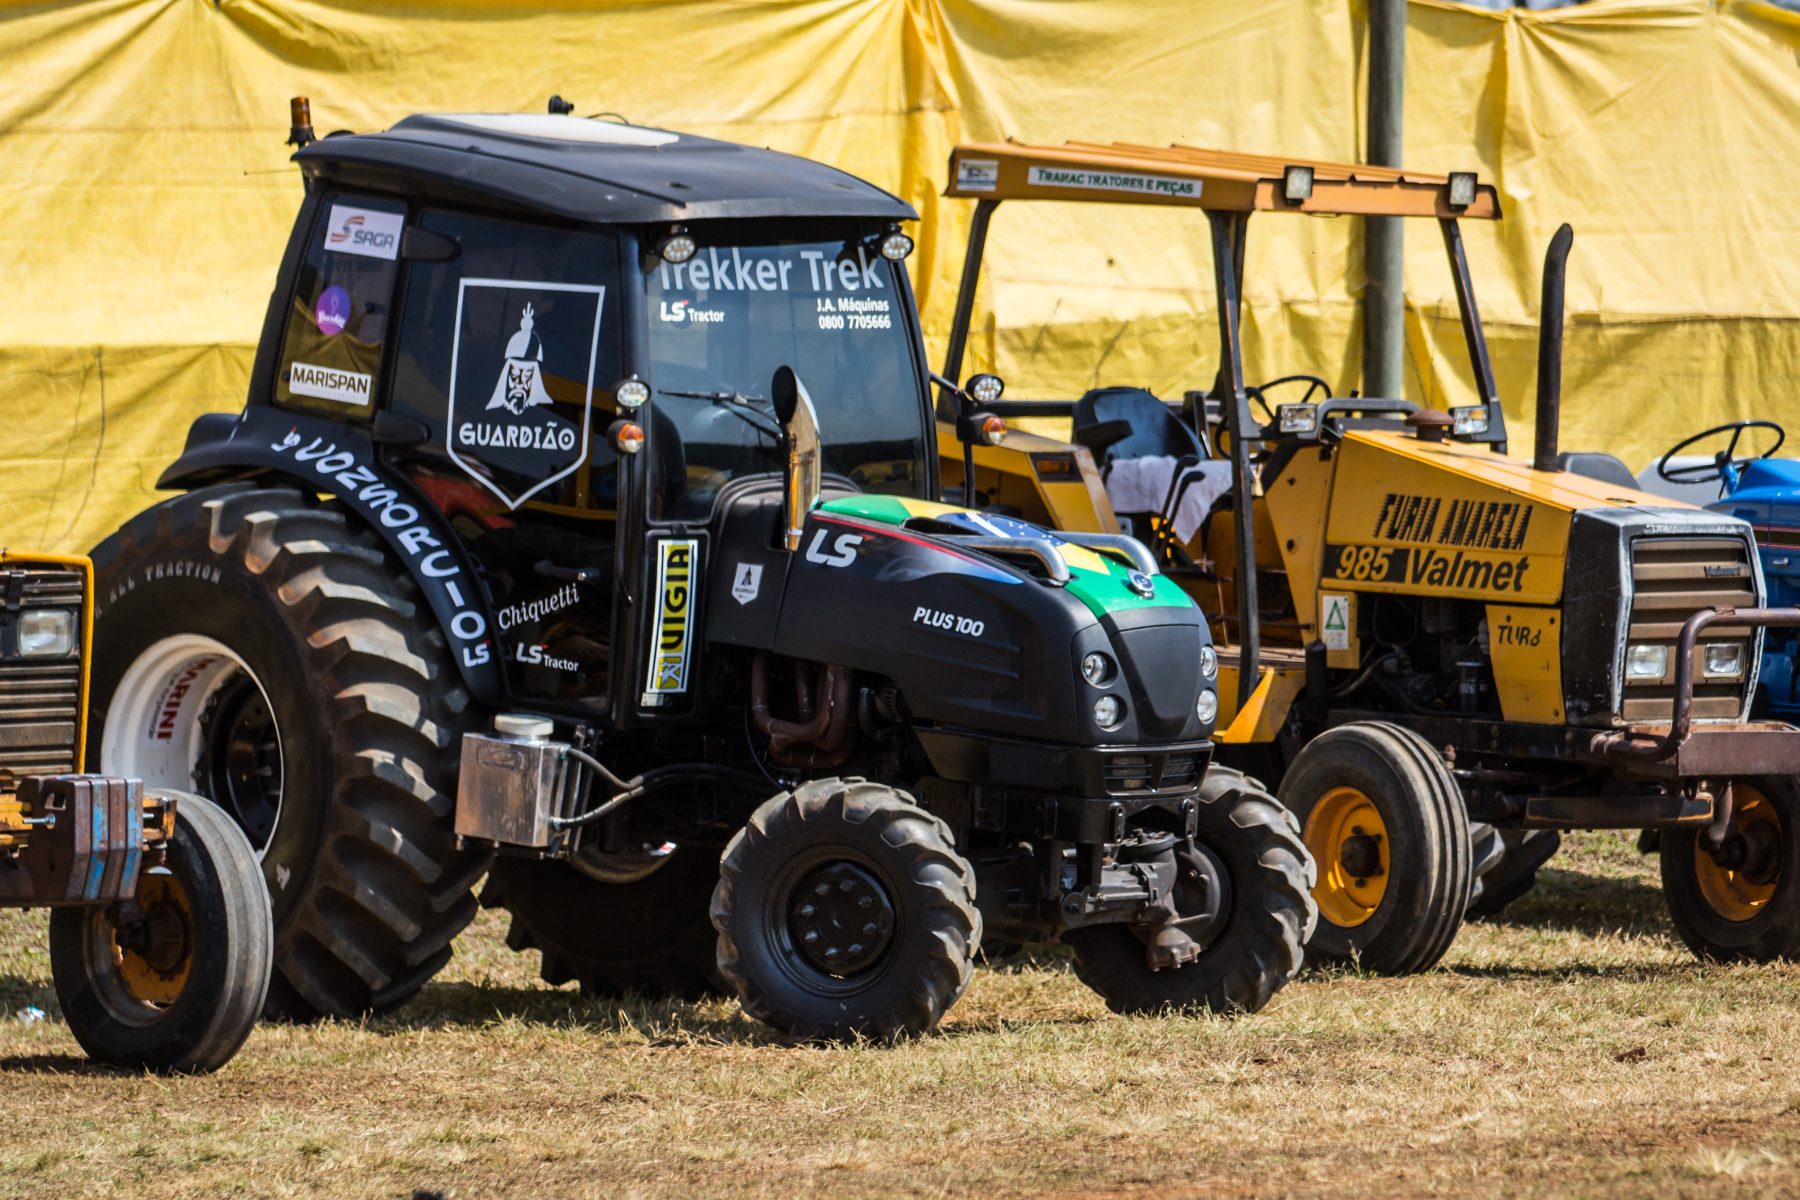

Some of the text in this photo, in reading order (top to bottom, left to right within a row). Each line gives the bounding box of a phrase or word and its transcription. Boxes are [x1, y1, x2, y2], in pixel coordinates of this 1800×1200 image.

[1036, 169, 1194, 196] TRAMAC TRATORES E PEÇAS
[352, 230, 395, 250] SAGA
[800, 246, 885, 292] Trek
[660, 301, 725, 323] LS Tractor
[816, 296, 890, 315] J.A. Máquinas
[818, 314, 892, 330] 0800 7705666
[293, 366, 368, 394] MARISPAN
[458, 421, 576, 451] GUARDIÃO
[805, 528, 864, 568] LS
[145, 560, 221, 585] TRACTION
[1335, 546, 1530, 593] 985 Valmet
[498, 582, 580, 630] Chiquetti
[913, 606, 985, 638] PLUS 100
[463, 641, 491, 668] LS
[516, 642, 580, 672] LS Tractor
